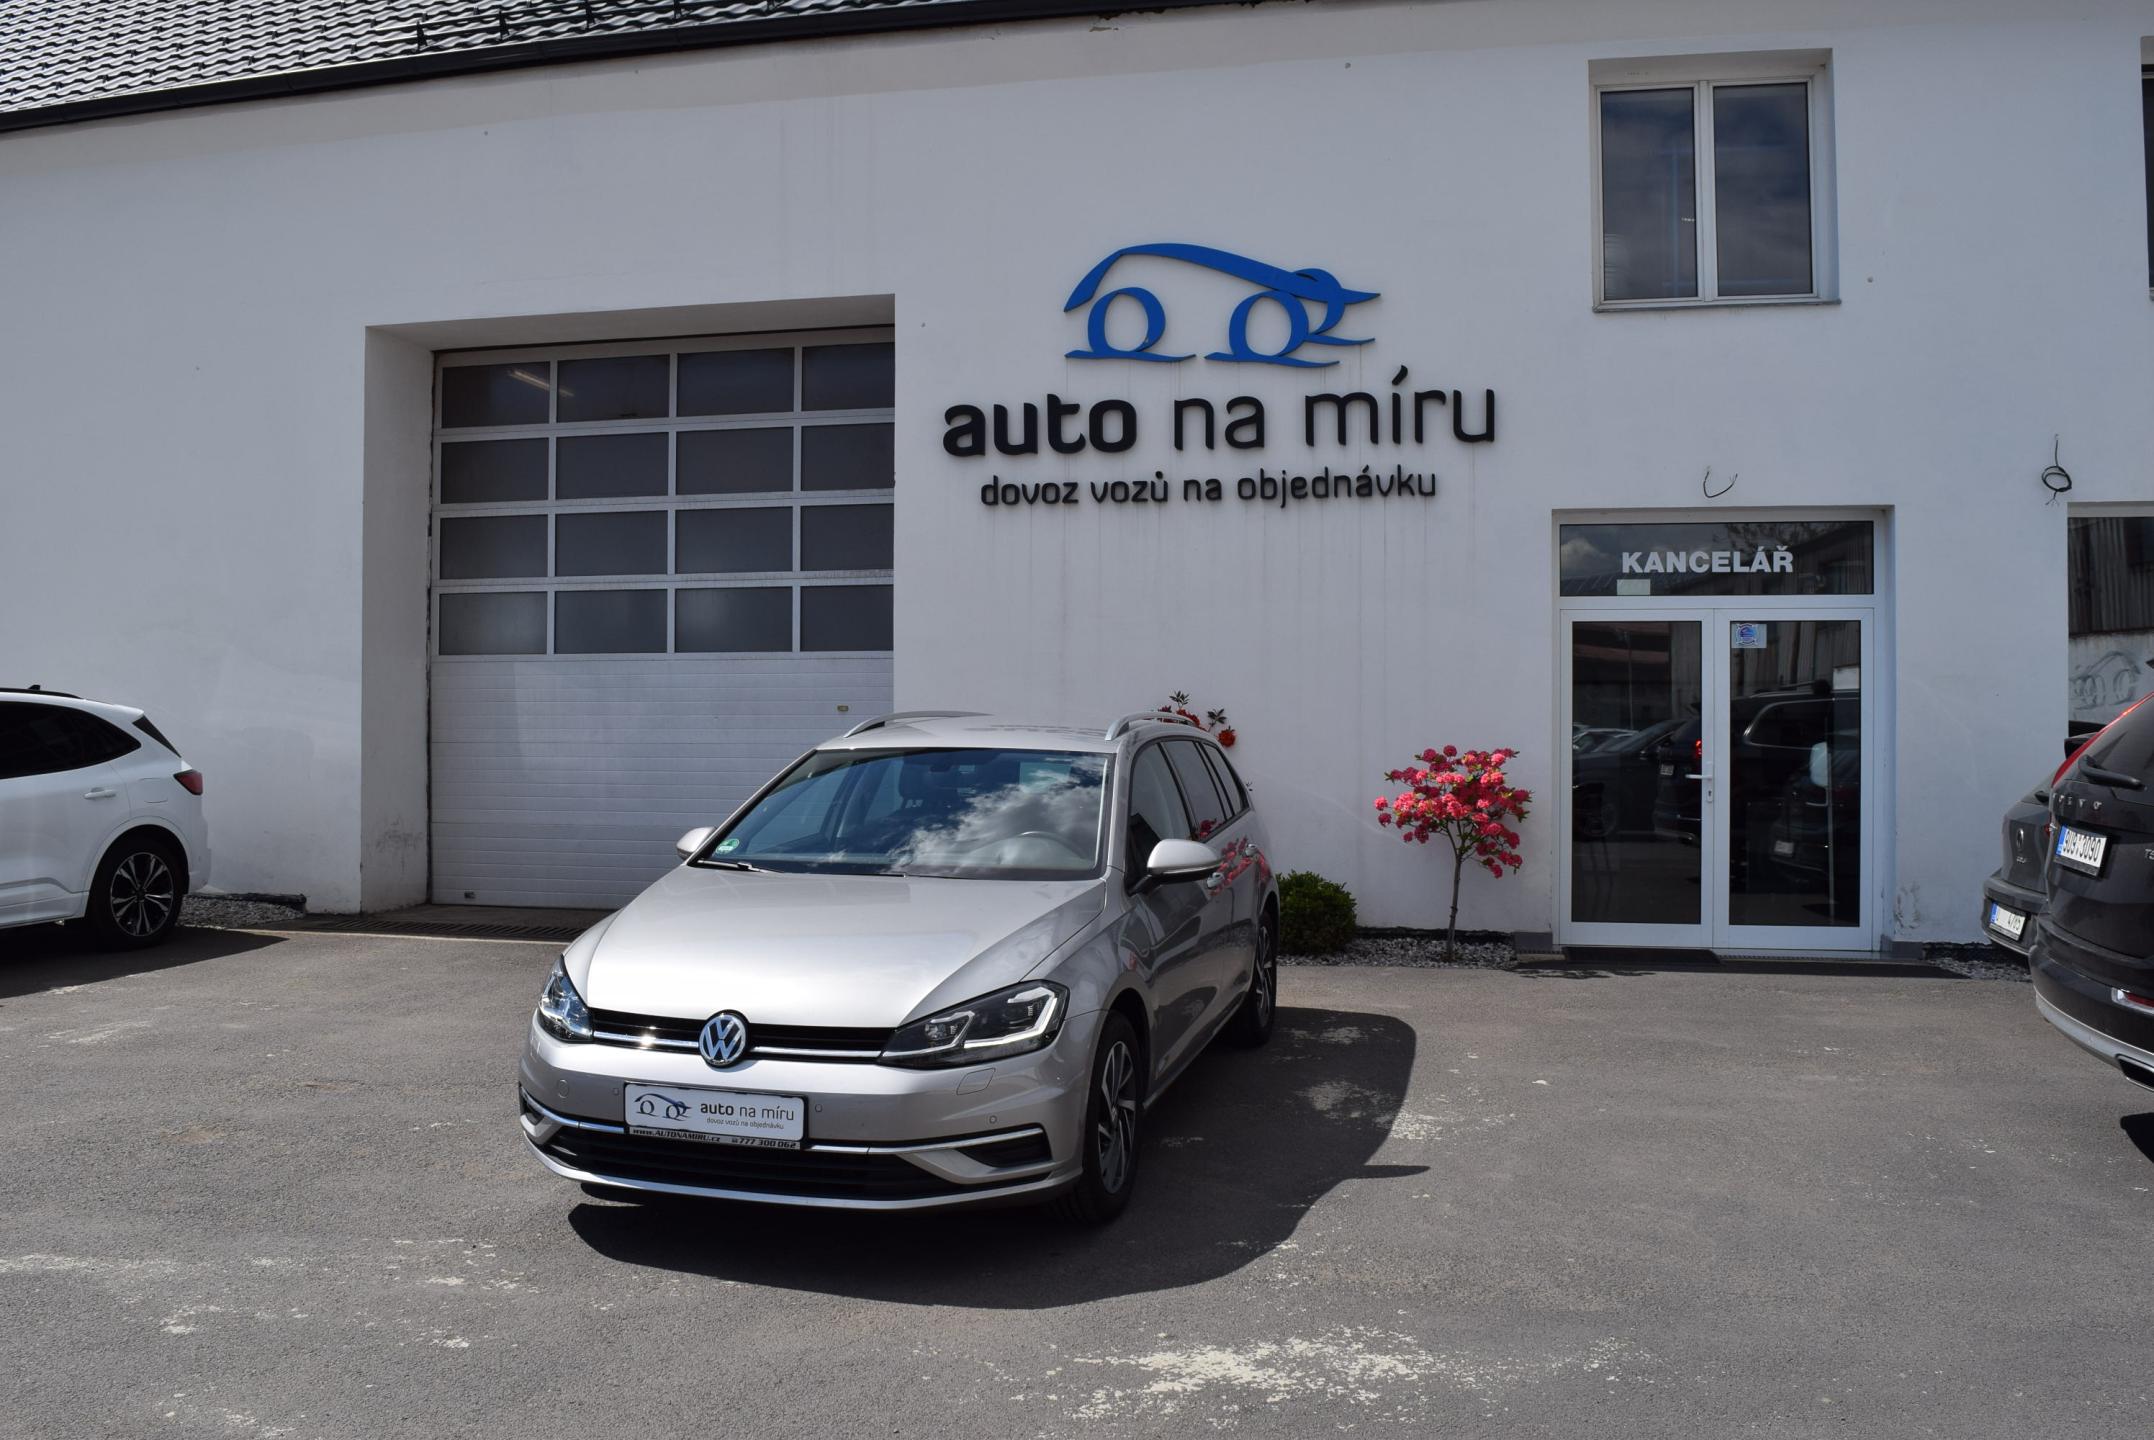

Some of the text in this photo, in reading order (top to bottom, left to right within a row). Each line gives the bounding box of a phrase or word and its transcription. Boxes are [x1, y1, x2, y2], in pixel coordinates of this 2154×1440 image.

[943, 365, 1495, 457] auto na míru
[980, 464, 1436, 508] dovoz vozů na objednávku
[1622, 546, 1794, 573] KANCELÁŘ
[700, 1103, 794, 1121] auto na míru
